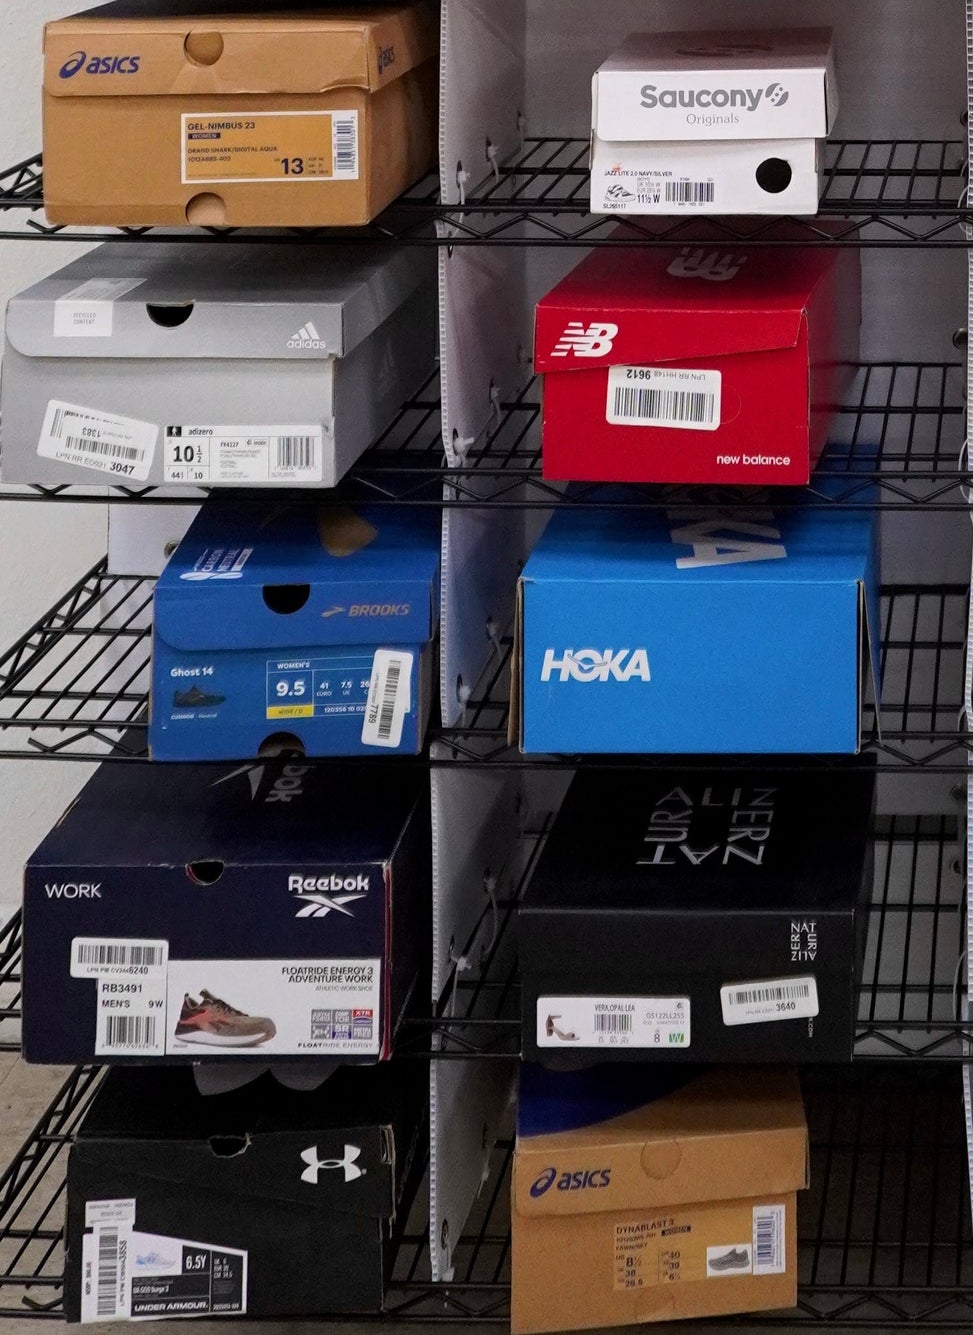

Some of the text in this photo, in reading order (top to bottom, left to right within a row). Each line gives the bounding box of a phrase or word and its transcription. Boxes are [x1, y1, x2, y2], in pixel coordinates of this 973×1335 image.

[86, 55, 140, 75] asics
[640, 85, 764, 111] Saucony
[686, 113, 739, 126] Originals
[188, 122, 243, 130] GEL-NIMBUS
[281, 158, 303, 175] 13
[286, 338, 326, 349] adidas
[550, 322, 618, 358] NB
[627, 369, 651, 380] 9612
[188, 428, 213, 437] adizero
[717, 454, 790, 466] new balance
[109, 461, 135, 475] 3047
[349, 604, 409, 616] BROOKS
[170, 666, 214, 677] Ghost 14
[277, 662, 310, 670] WOMEN'S
[540, 649, 651, 682] HOKA
[276, 681, 305, 696] 9.5
[369, 705, 378, 724] 7789
[288, 874, 369, 891] Reebok
[45, 882, 101, 899] WORK
[282, 967, 373, 975] FLOATRIDE ENERGY 3
[288, 975, 373, 983] ADVENTURE WORK
[102, 984, 142, 993] RB3491
[102, 1000, 130, 1008] MEN'S
[776, 1002, 796, 1012] 3640
[654, 1032, 661, 1043] 8
[557, 1168, 611, 1191] asics
[617, 1220, 667, 1234] DYNABLAST
[185, 1255, 207, 1269] 6.5Y
[135, 1302, 206, 1312] UNDER ARMOUR
